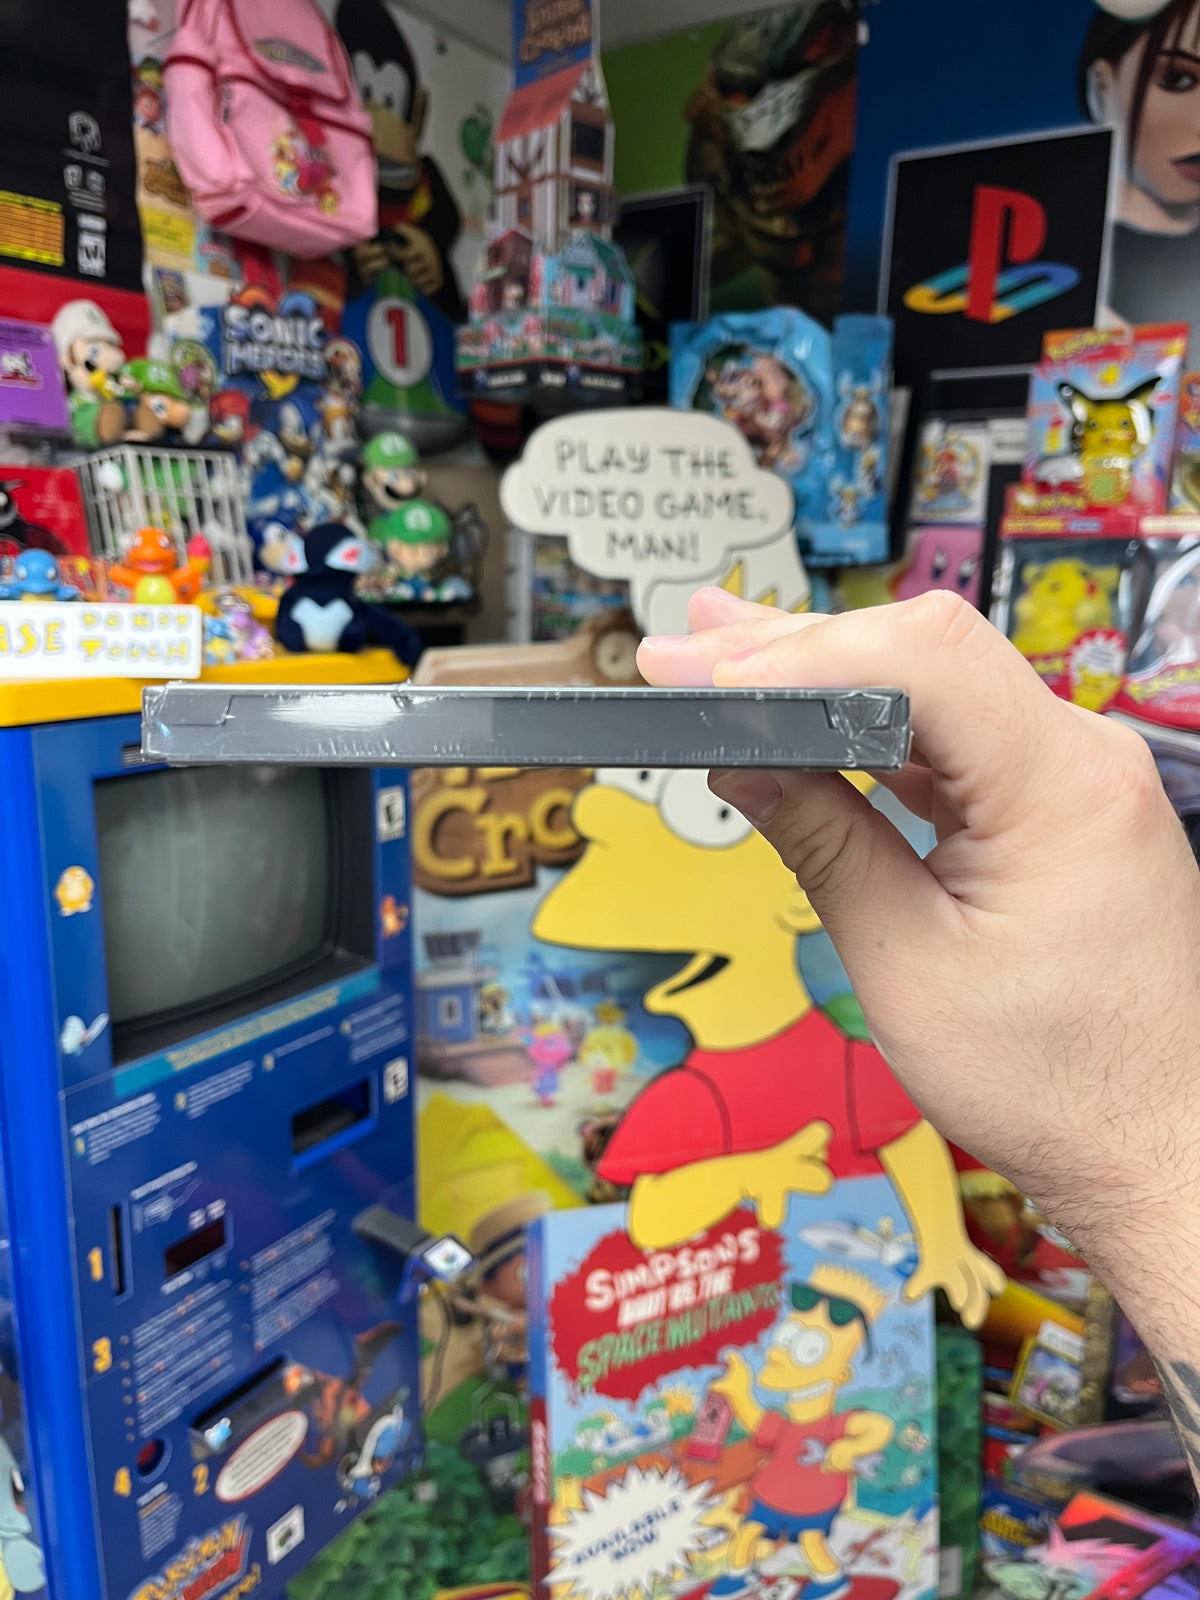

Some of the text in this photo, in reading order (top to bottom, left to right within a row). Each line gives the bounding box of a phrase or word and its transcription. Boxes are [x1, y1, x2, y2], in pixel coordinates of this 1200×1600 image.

[225, 305, 326, 348] SONIC
[385, 307, 408, 370] 1
[554, 439, 739, 478] PLAY THE
[532, 482, 645, 520] VIDEO
[606, 532, 699, 562] MAN!
